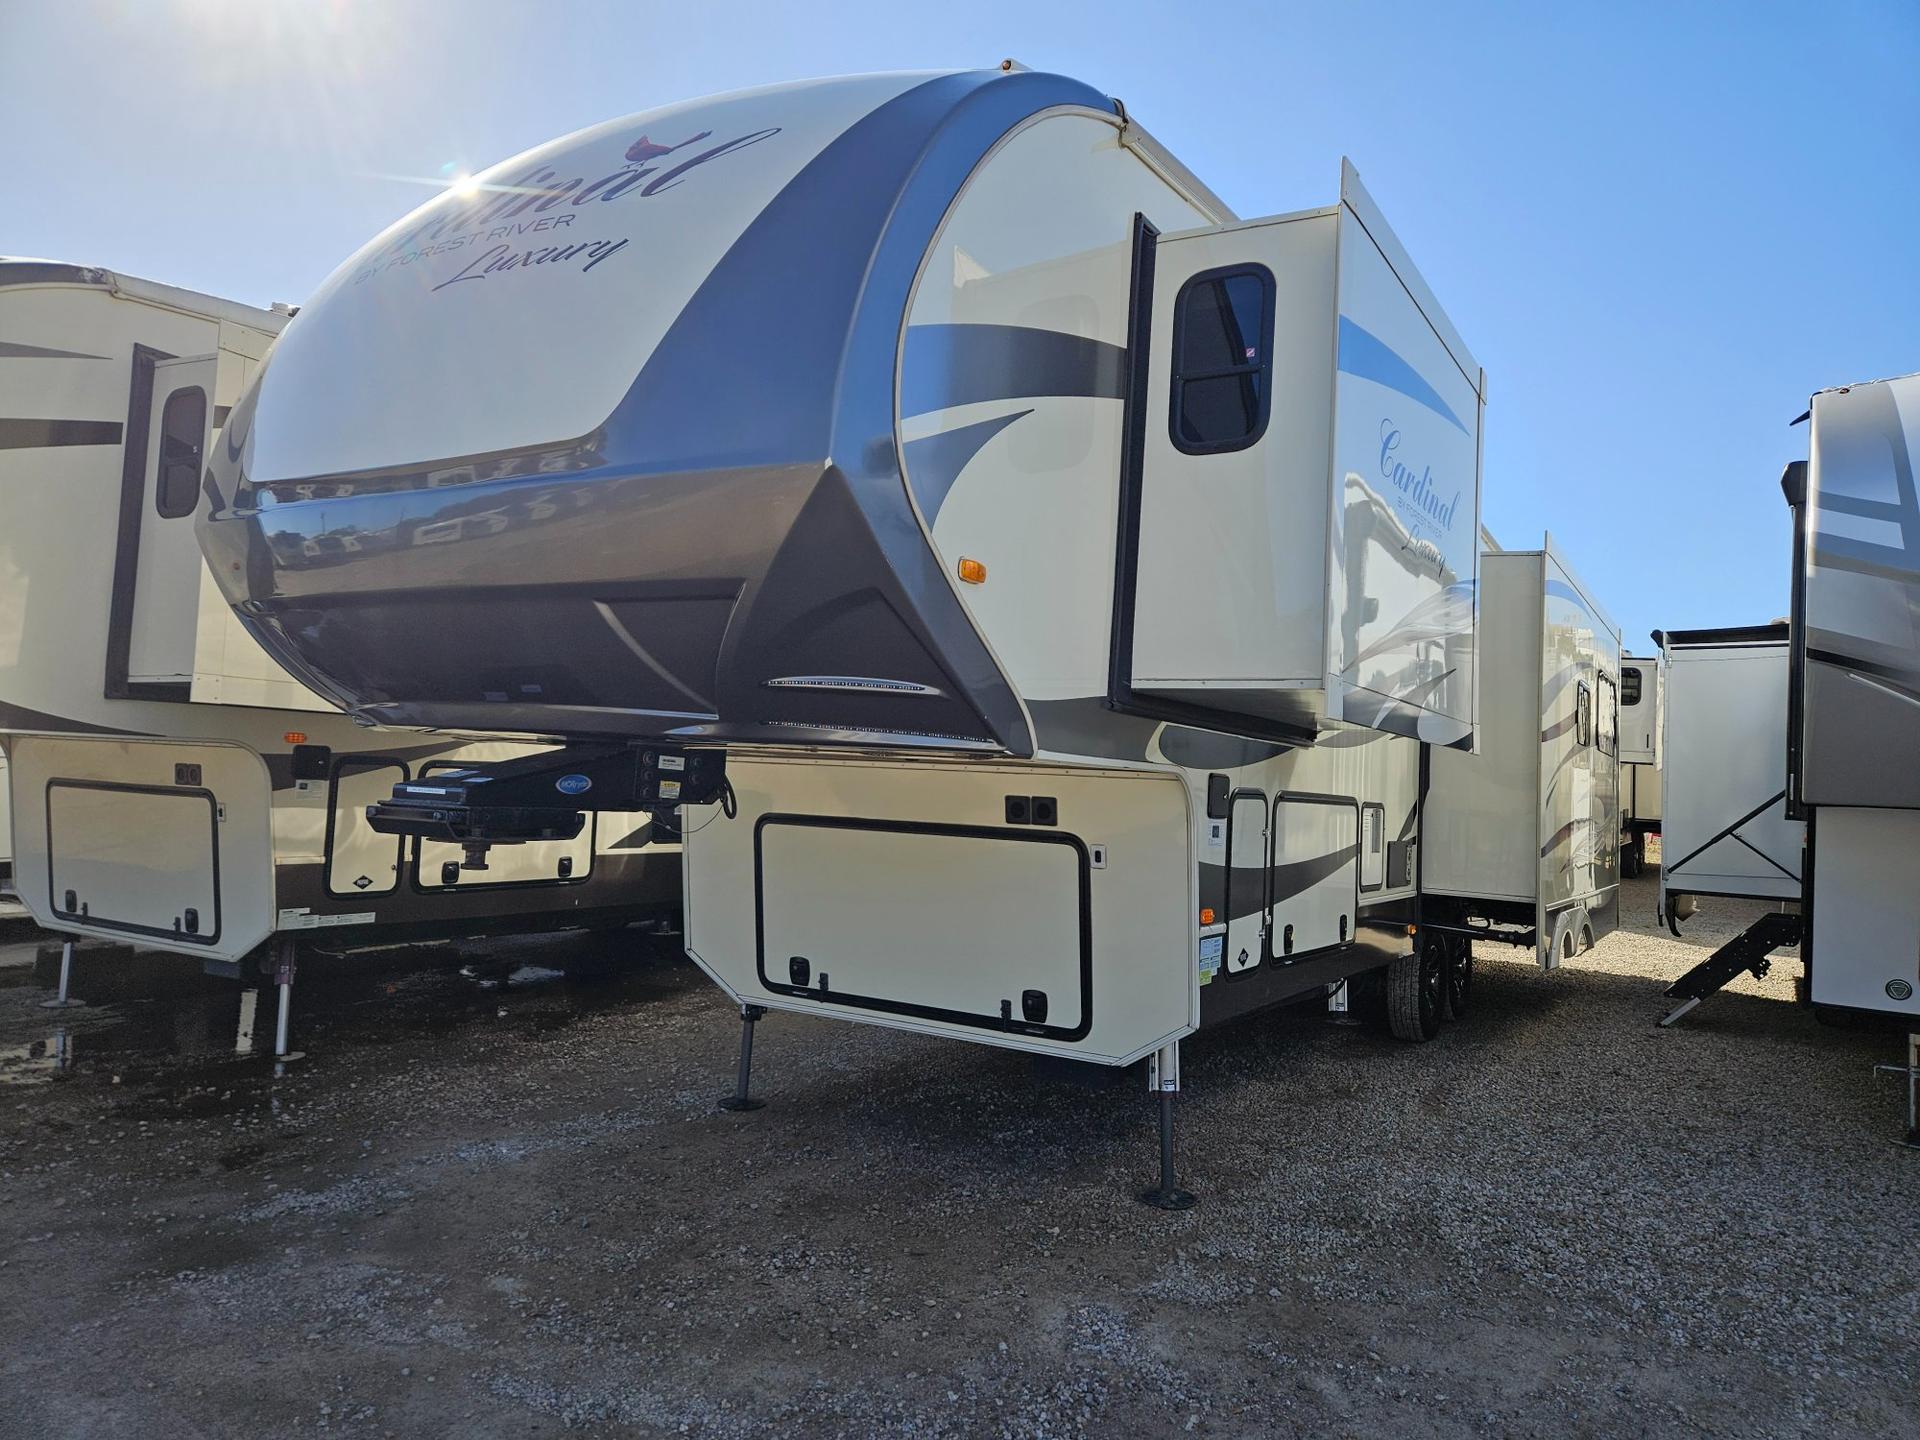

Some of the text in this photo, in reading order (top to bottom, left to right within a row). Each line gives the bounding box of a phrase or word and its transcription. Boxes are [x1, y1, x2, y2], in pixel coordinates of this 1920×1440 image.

[378, 127, 783, 258] dinal
[386, 231, 485, 272] FOREST
[486, 213, 577, 242] RIVER
[431, 237, 630, 292] Luxury
[1380, 418, 1461, 532] Cardinal
